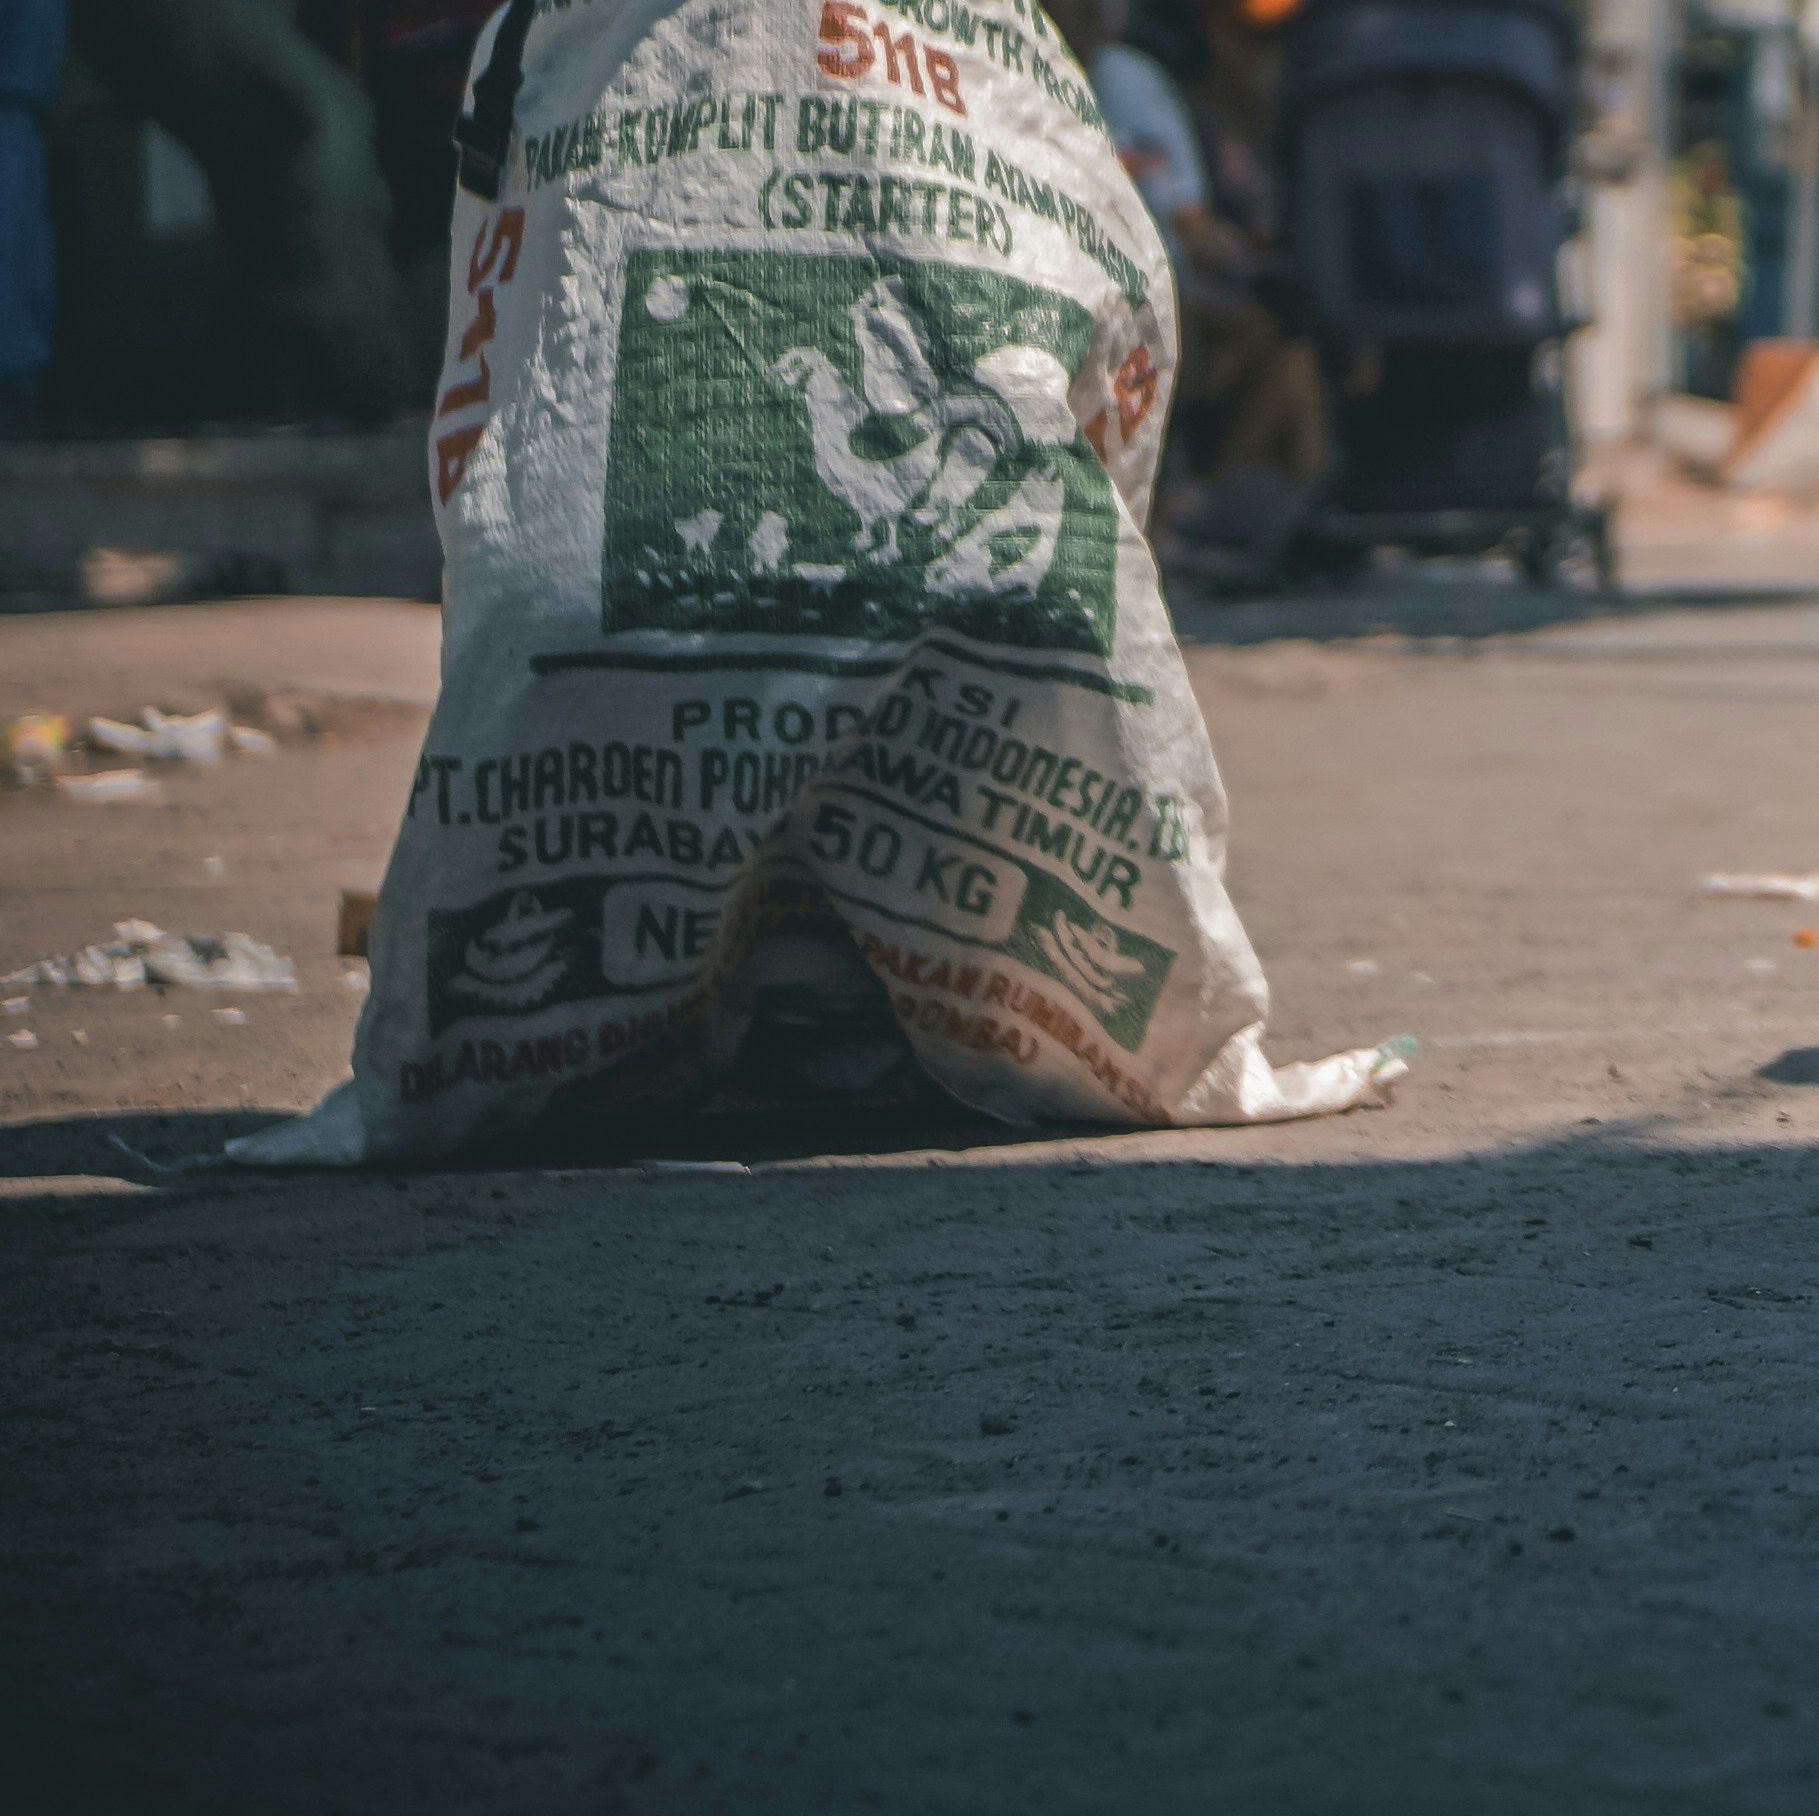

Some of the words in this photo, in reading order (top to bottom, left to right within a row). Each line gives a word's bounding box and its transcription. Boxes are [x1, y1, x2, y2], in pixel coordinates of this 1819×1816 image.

[799, 95, 976, 184] BUTIRAN
[758, 167, 1013, 257] (STARTER)
[811, 802, 901, 878] 50
[915, 844, 1000, 917] KG
[976, 785, 1142, 911] TIMUR
